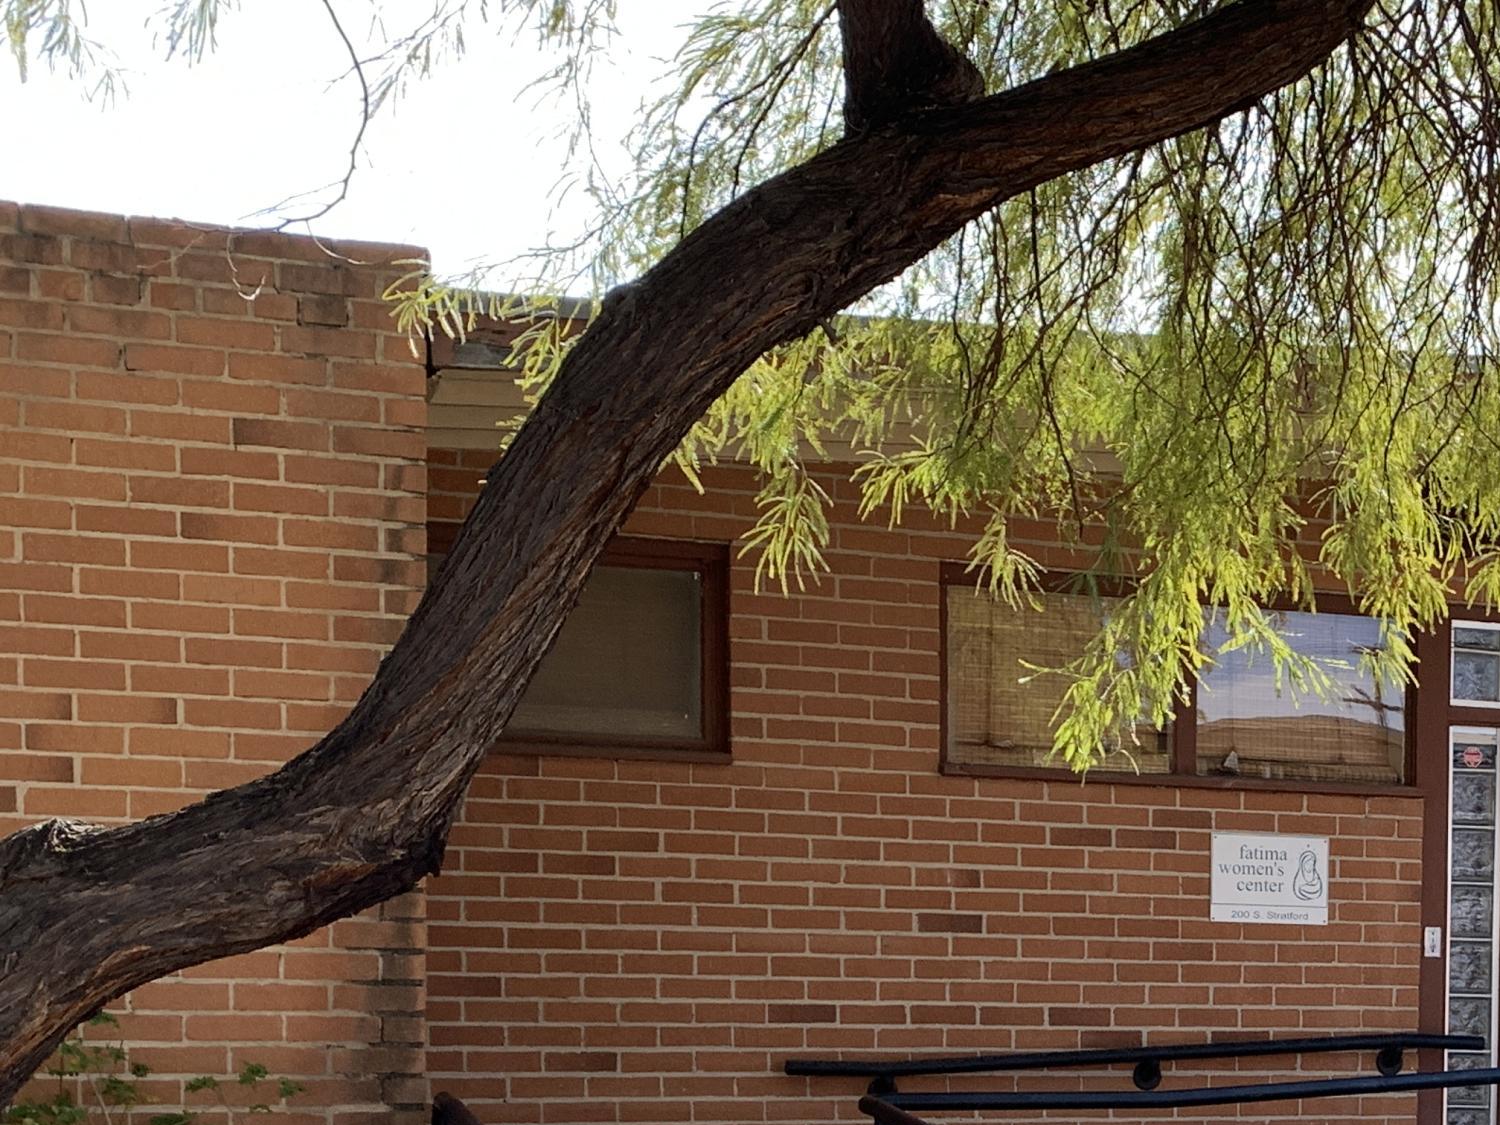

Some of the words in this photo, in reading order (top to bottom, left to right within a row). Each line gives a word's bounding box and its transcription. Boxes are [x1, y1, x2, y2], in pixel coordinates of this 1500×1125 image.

[1240, 844, 1288, 861] fatima
[1219, 862, 1285, 877] women's
[1236, 881, 1285, 893] center
[1231, 910, 1250, 919] 200
[1266, 911, 1309, 921] Stratford
